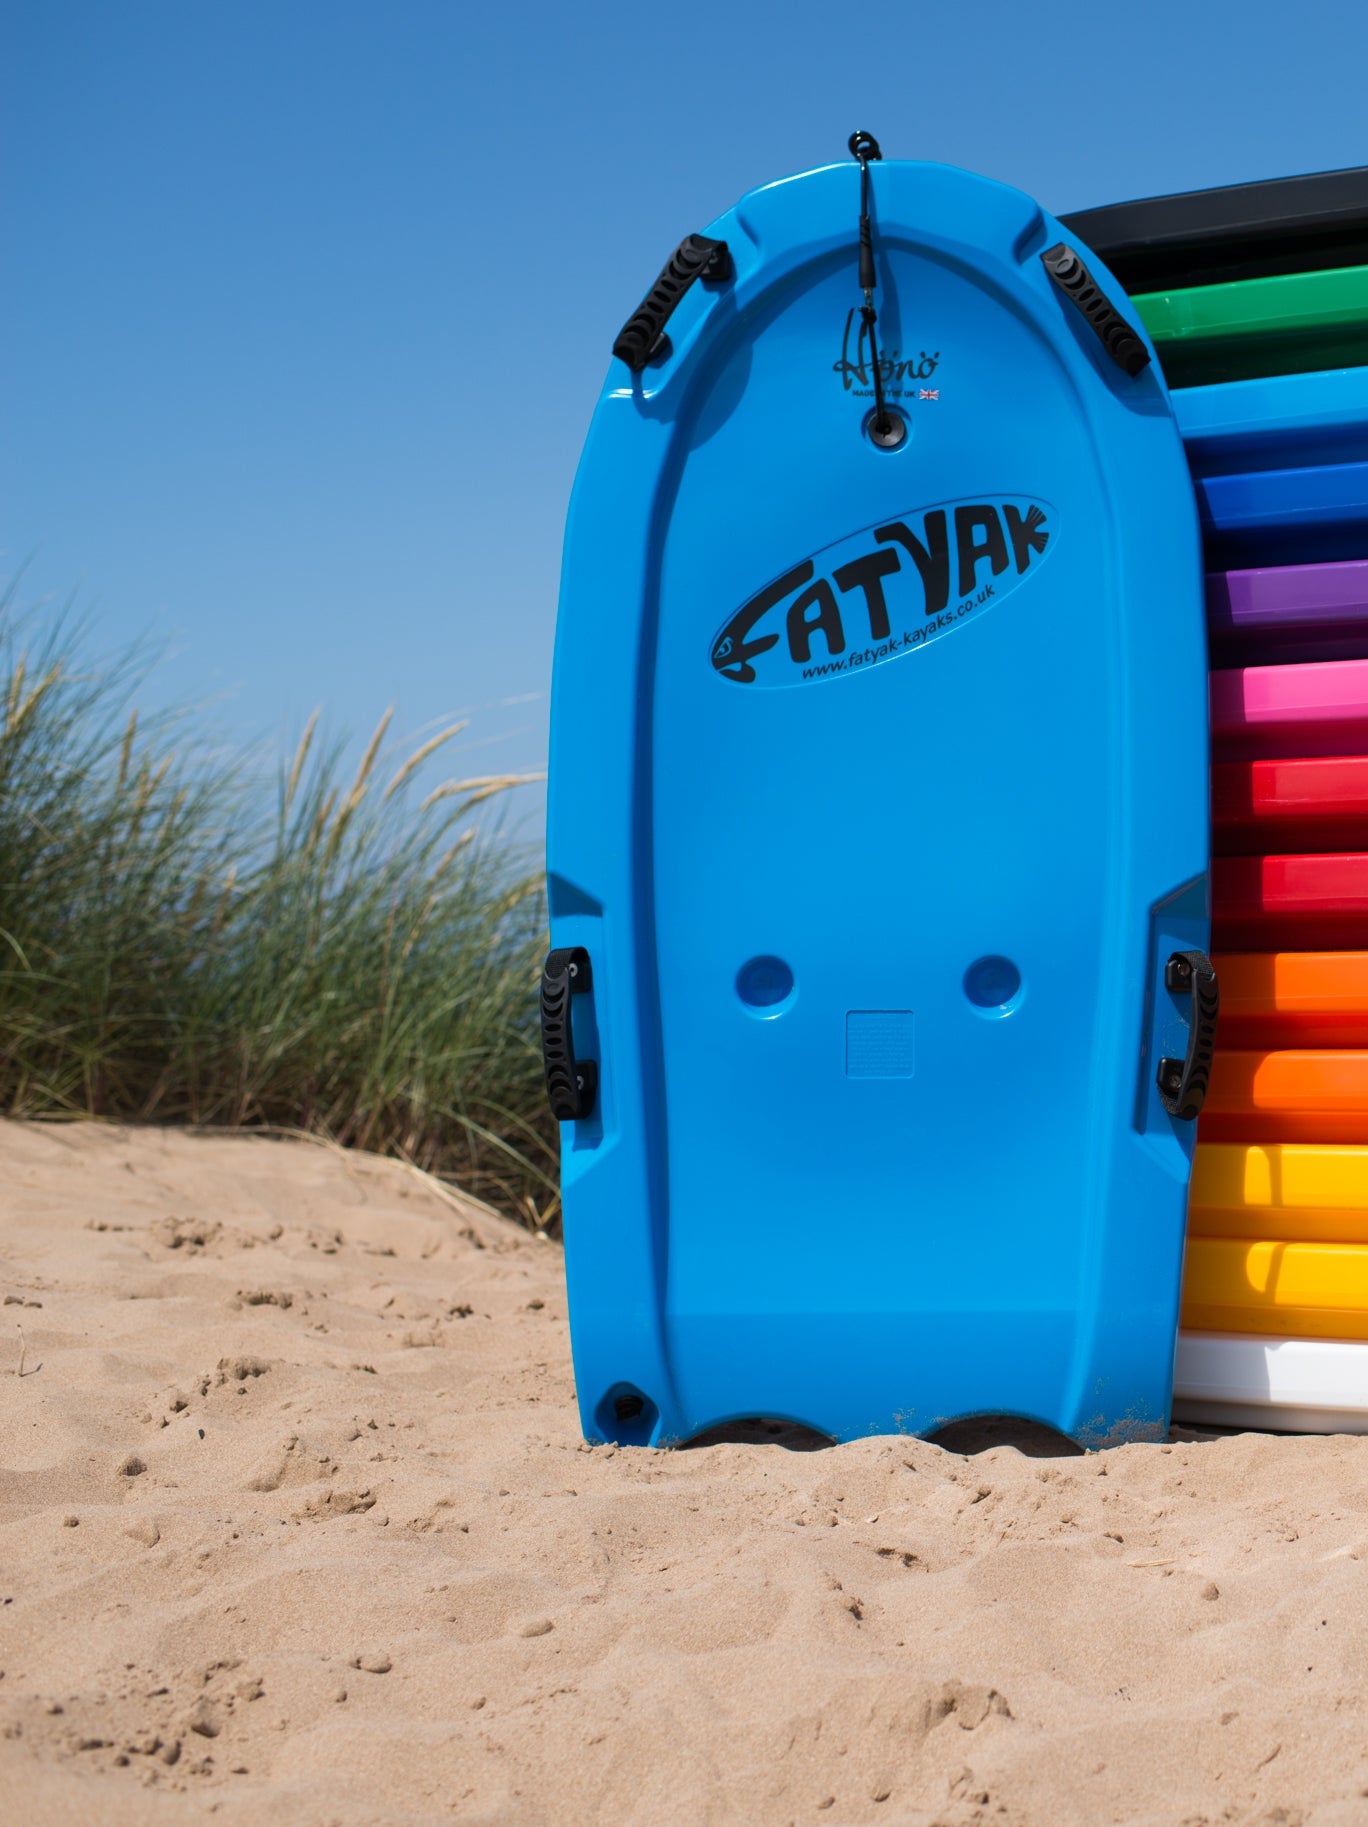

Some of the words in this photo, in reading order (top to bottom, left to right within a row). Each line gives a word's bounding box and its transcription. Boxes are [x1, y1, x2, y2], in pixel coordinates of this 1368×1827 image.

[904, 390, 916, 398] UK
[711, 504, 1050, 683] FATYAK
[802, 583, 996, 680] www.fatyak-kayaks.co.uk
